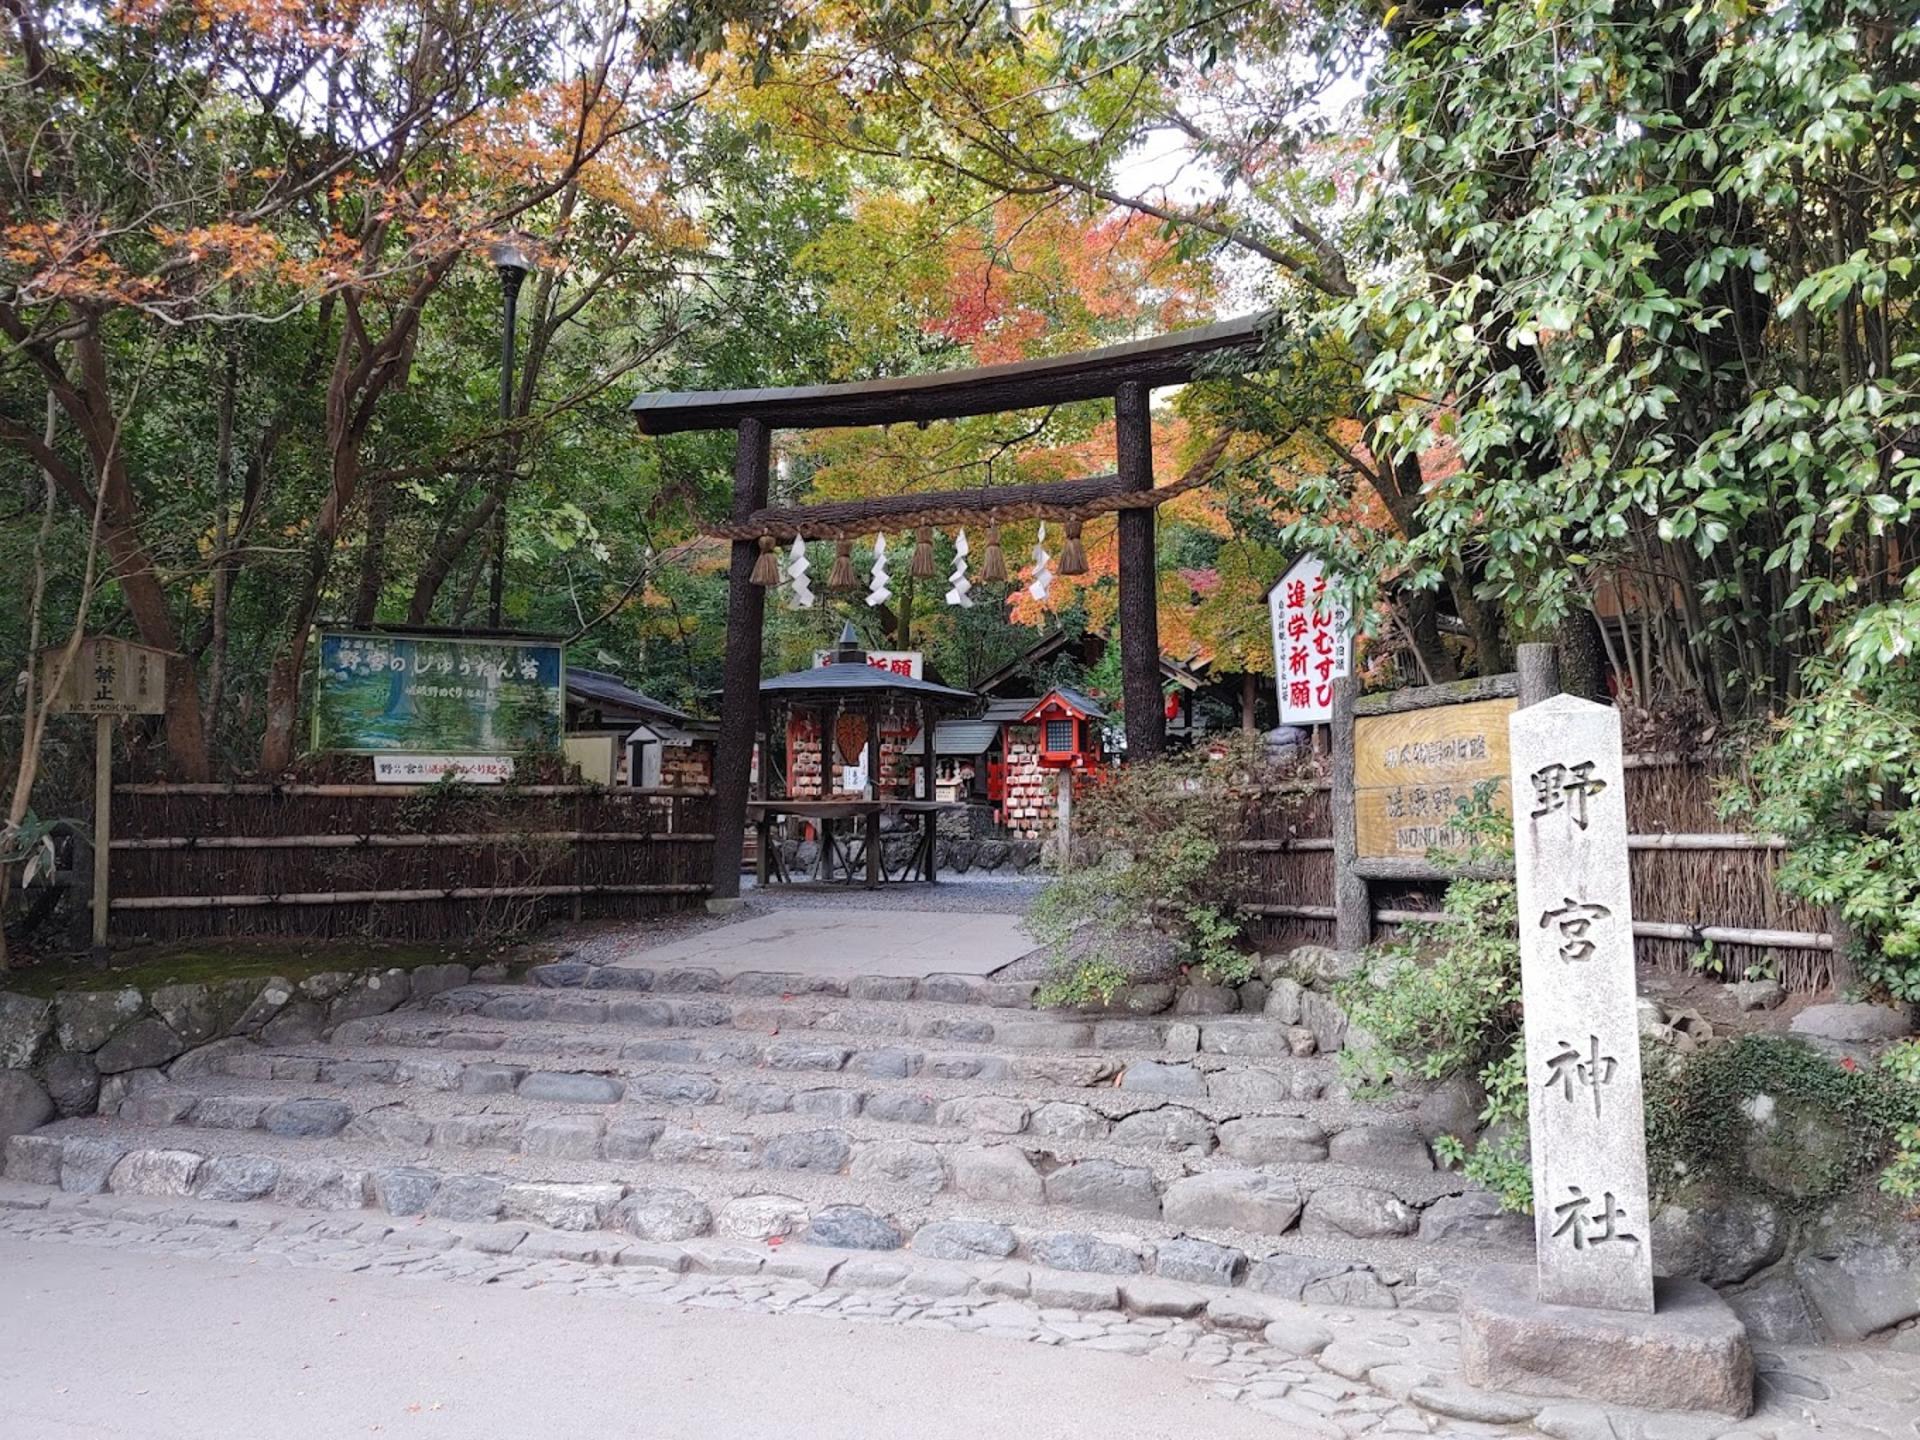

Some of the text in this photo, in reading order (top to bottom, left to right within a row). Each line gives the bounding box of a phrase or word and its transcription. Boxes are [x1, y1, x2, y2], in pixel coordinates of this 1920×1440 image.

[1286, 579, 1311, 709] 進学祈願
[94, 665, 117, 701] 禁止
[89, 704, 137, 712] SMOKING
[1397, 827, 1479, 848] NONOMIYA
[1530, 760, 1639, 1250] 野宮神社
